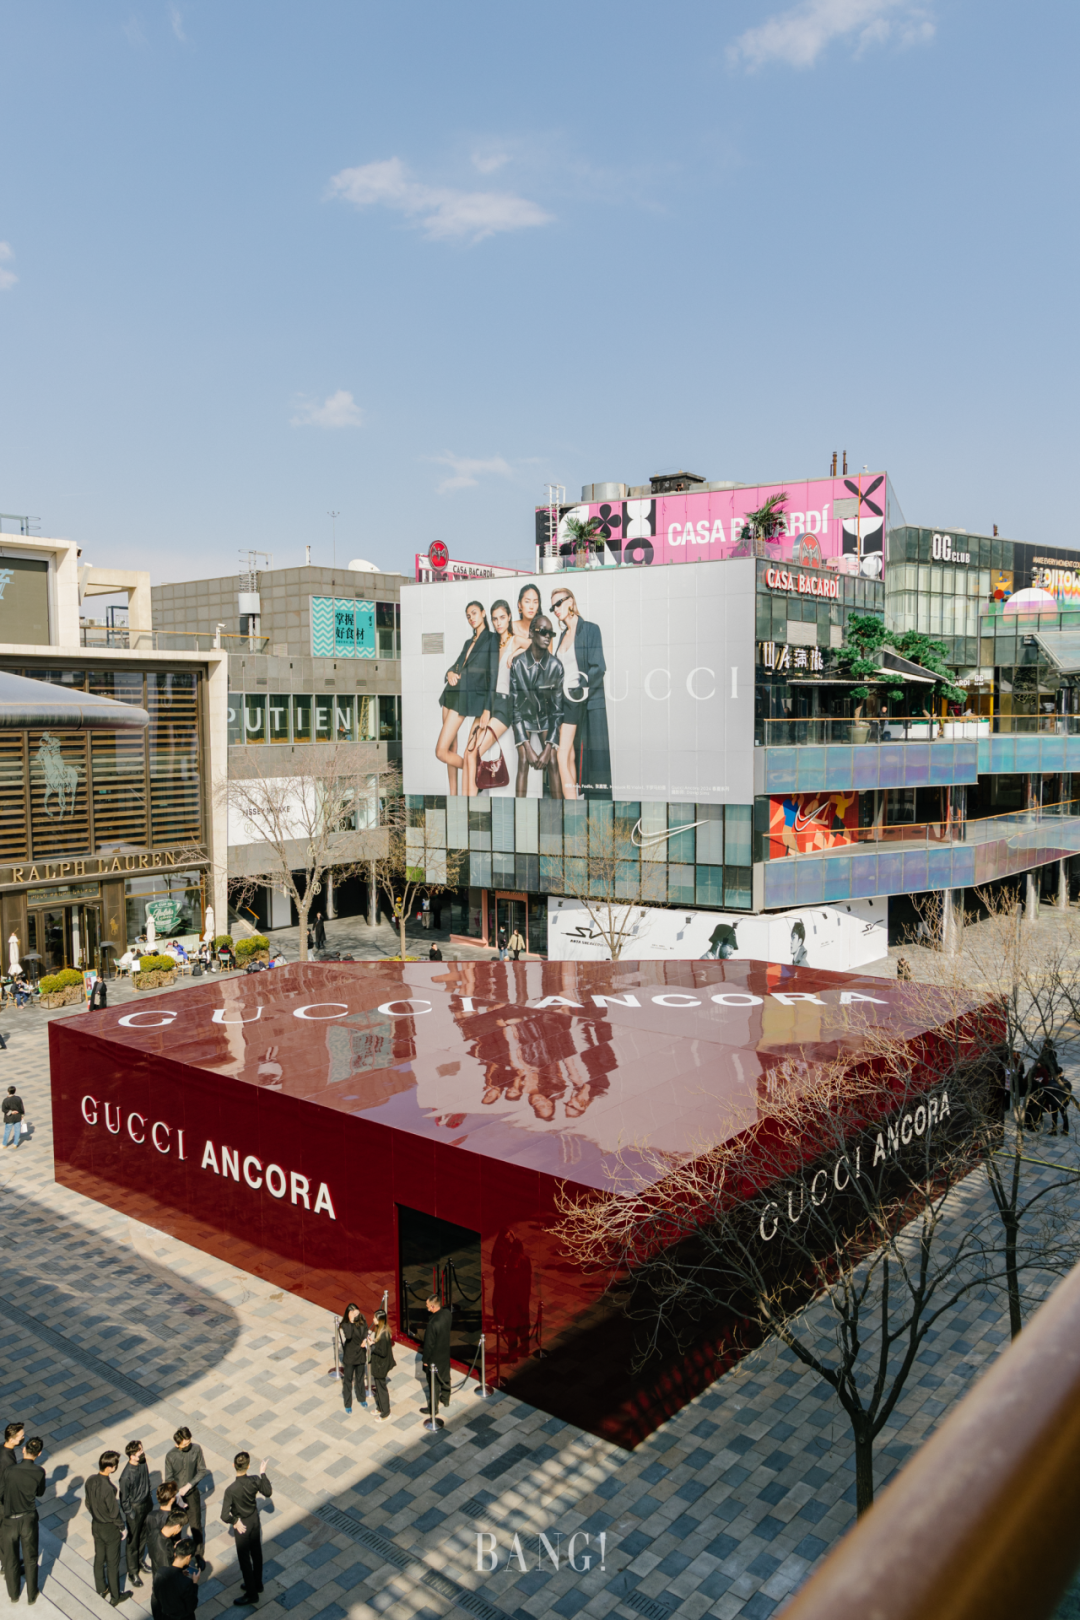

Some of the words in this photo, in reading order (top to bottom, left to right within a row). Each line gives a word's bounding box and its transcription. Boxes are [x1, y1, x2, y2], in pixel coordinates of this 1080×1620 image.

[668, 519, 726, 546] CASA
[731, 504, 830, 542] BARDÍ
[932, 534, 952, 561] OG
[951, 551, 971, 564] CLUB
[453, 565, 467, 574] CASA
[766, 568, 794, 591] CASA
[797, 574, 840, 598] BACARDÍ
[335, 627, 364, 640] 好食材
[563, 667, 738, 703] GUCCI
[12, 861, 86, 883] RALPH
[98, 851, 175, 873] LAUREN
[118, 997, 477, 1028] GUCCI
[533, 991, 889, 1008] ANCORA
[872, 1091, 950, 1167] ANCORA
[81, 1095, 188, 1161] GUCCI
[201, 1140, 337, 1220] ANCORA
